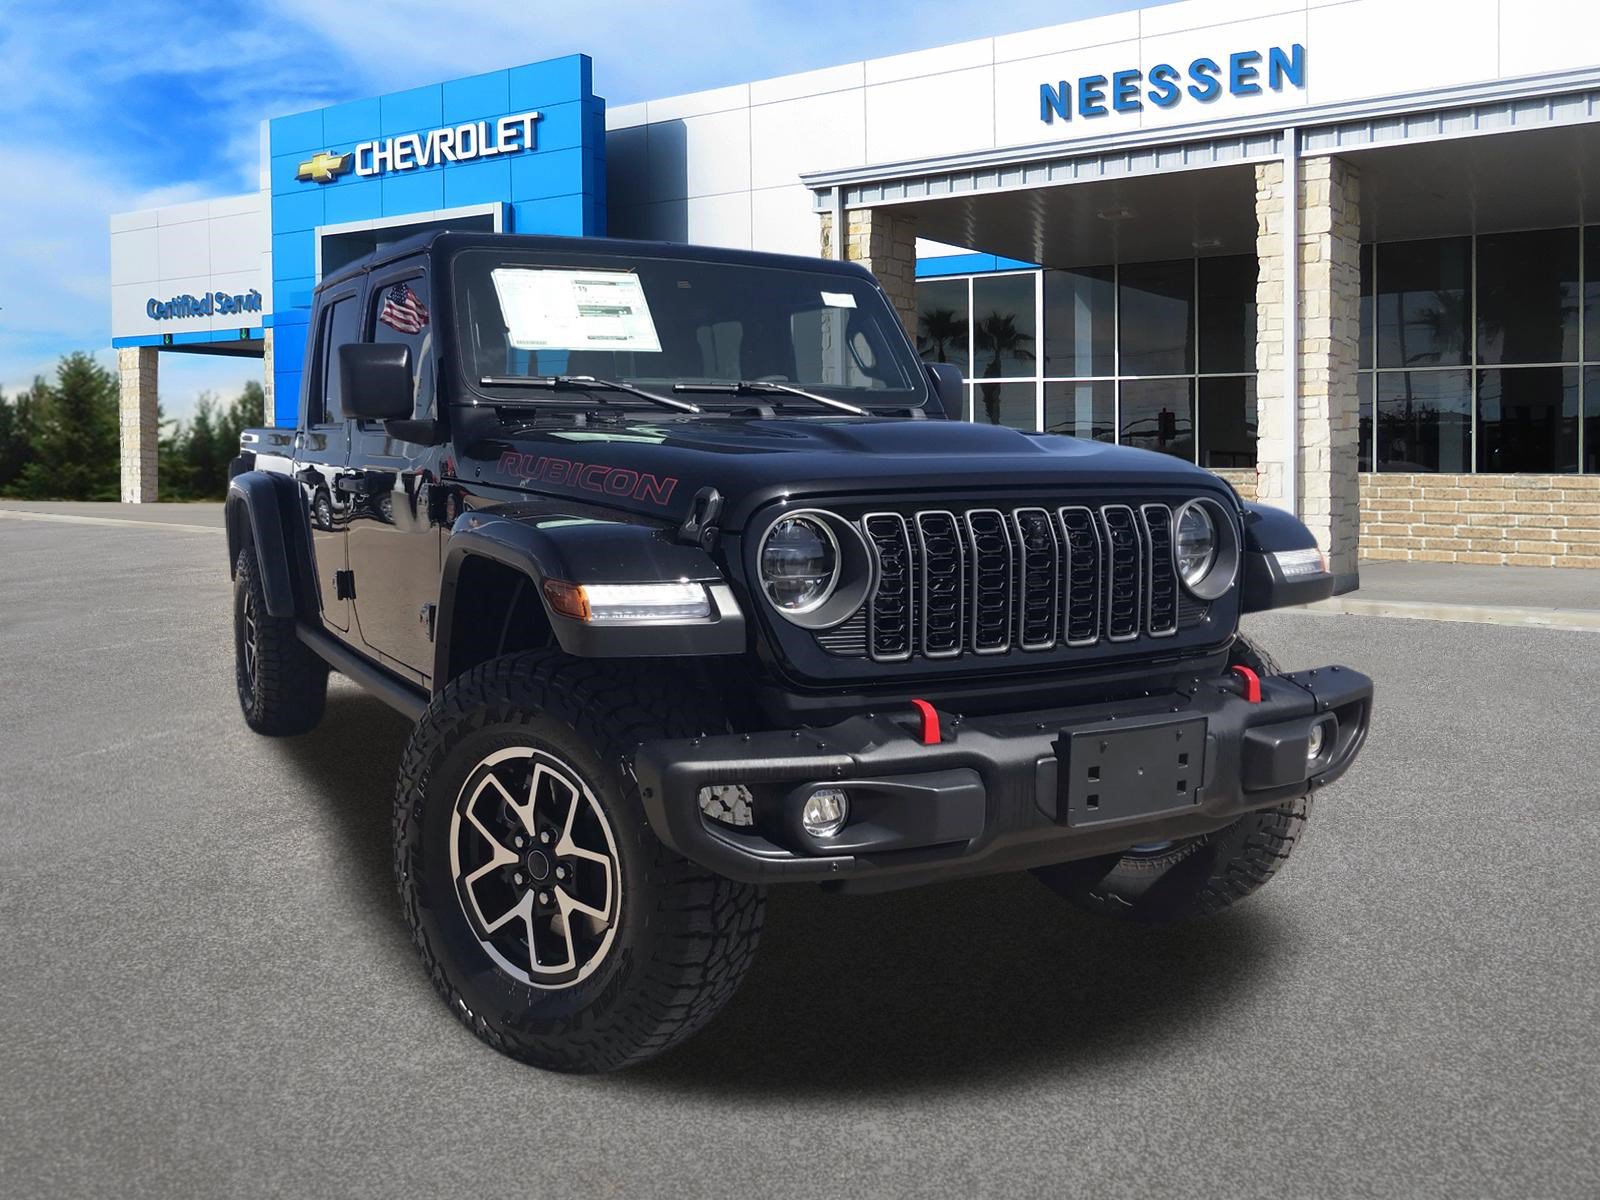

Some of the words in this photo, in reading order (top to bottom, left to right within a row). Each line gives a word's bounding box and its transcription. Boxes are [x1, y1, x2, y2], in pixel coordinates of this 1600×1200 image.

[1040, 43, 1305, 123] NEESSEN
[354, 111, 543, 177] CHEVROLET
[146, 292, 214, 320] Certified
[496, 451, 678, 506] RUBICON
